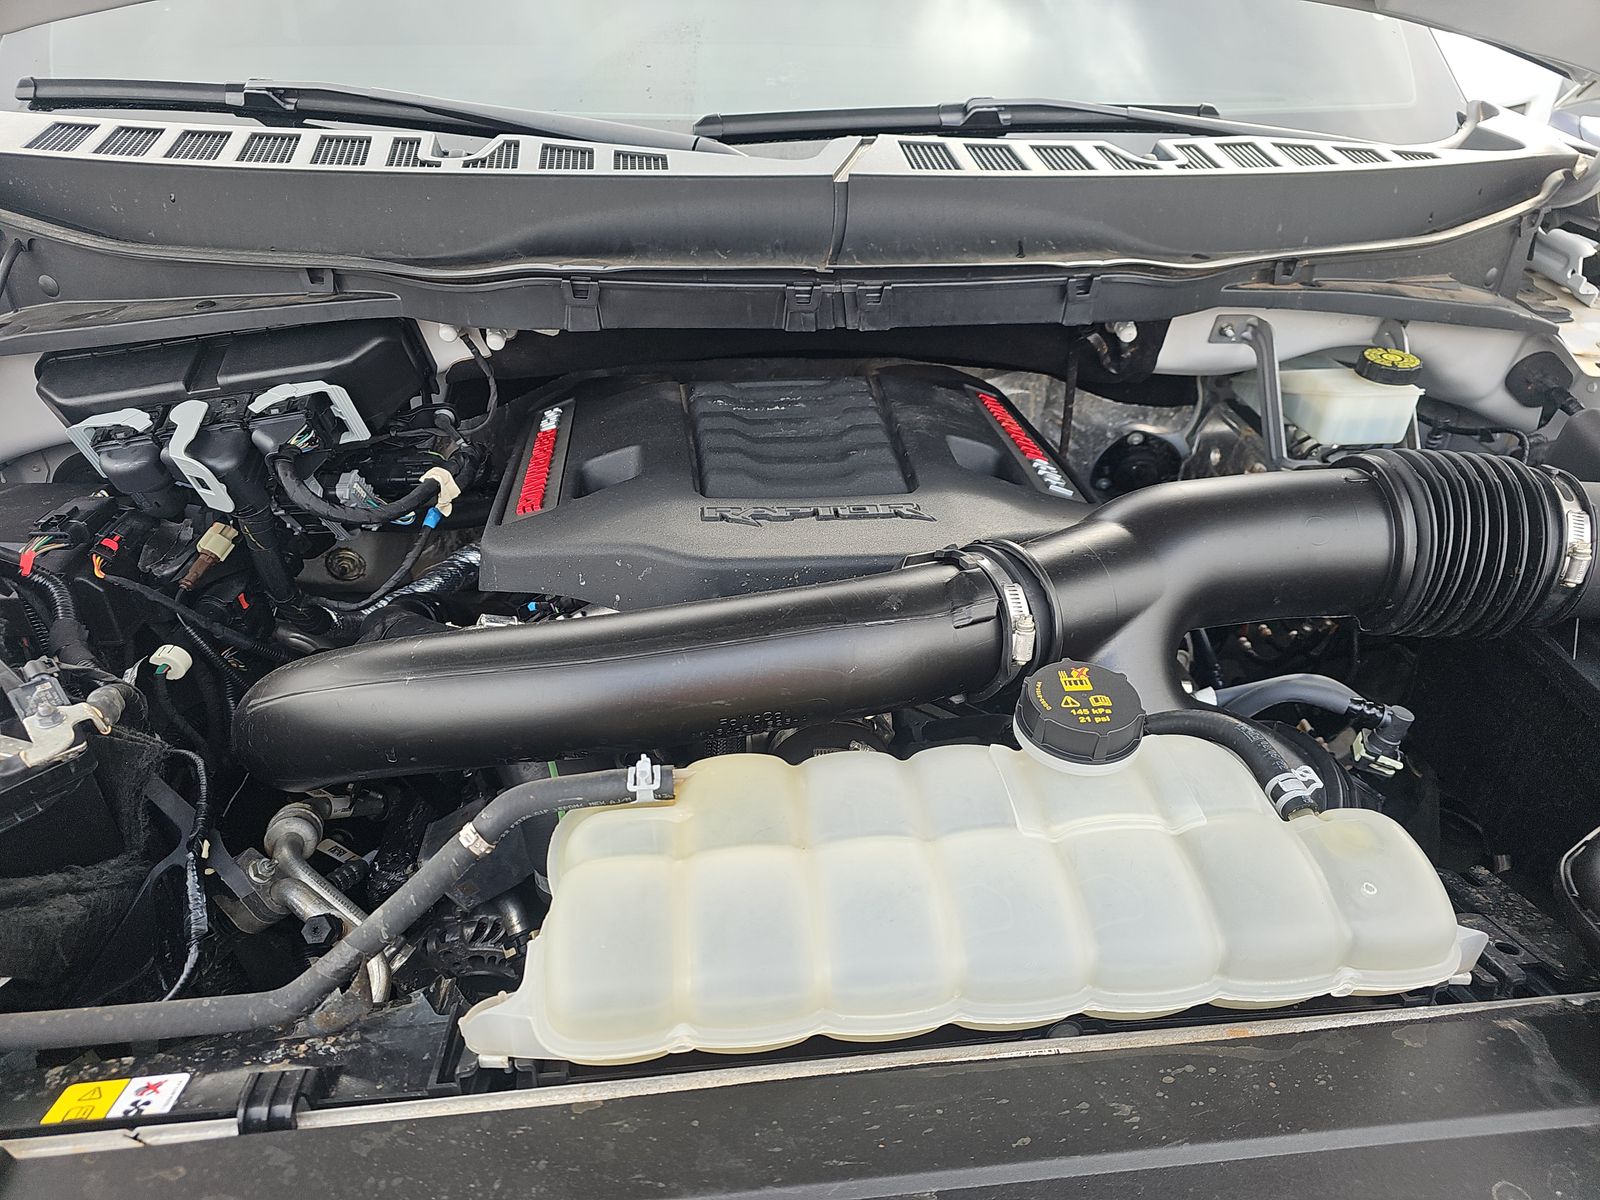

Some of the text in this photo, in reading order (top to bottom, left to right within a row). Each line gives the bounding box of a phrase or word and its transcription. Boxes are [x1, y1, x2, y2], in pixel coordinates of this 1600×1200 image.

[699, 502, 937, 527] RAPTOR
[1091, 707, 1112, 715] kPa
[1094, 715, 1110, 724] psi
